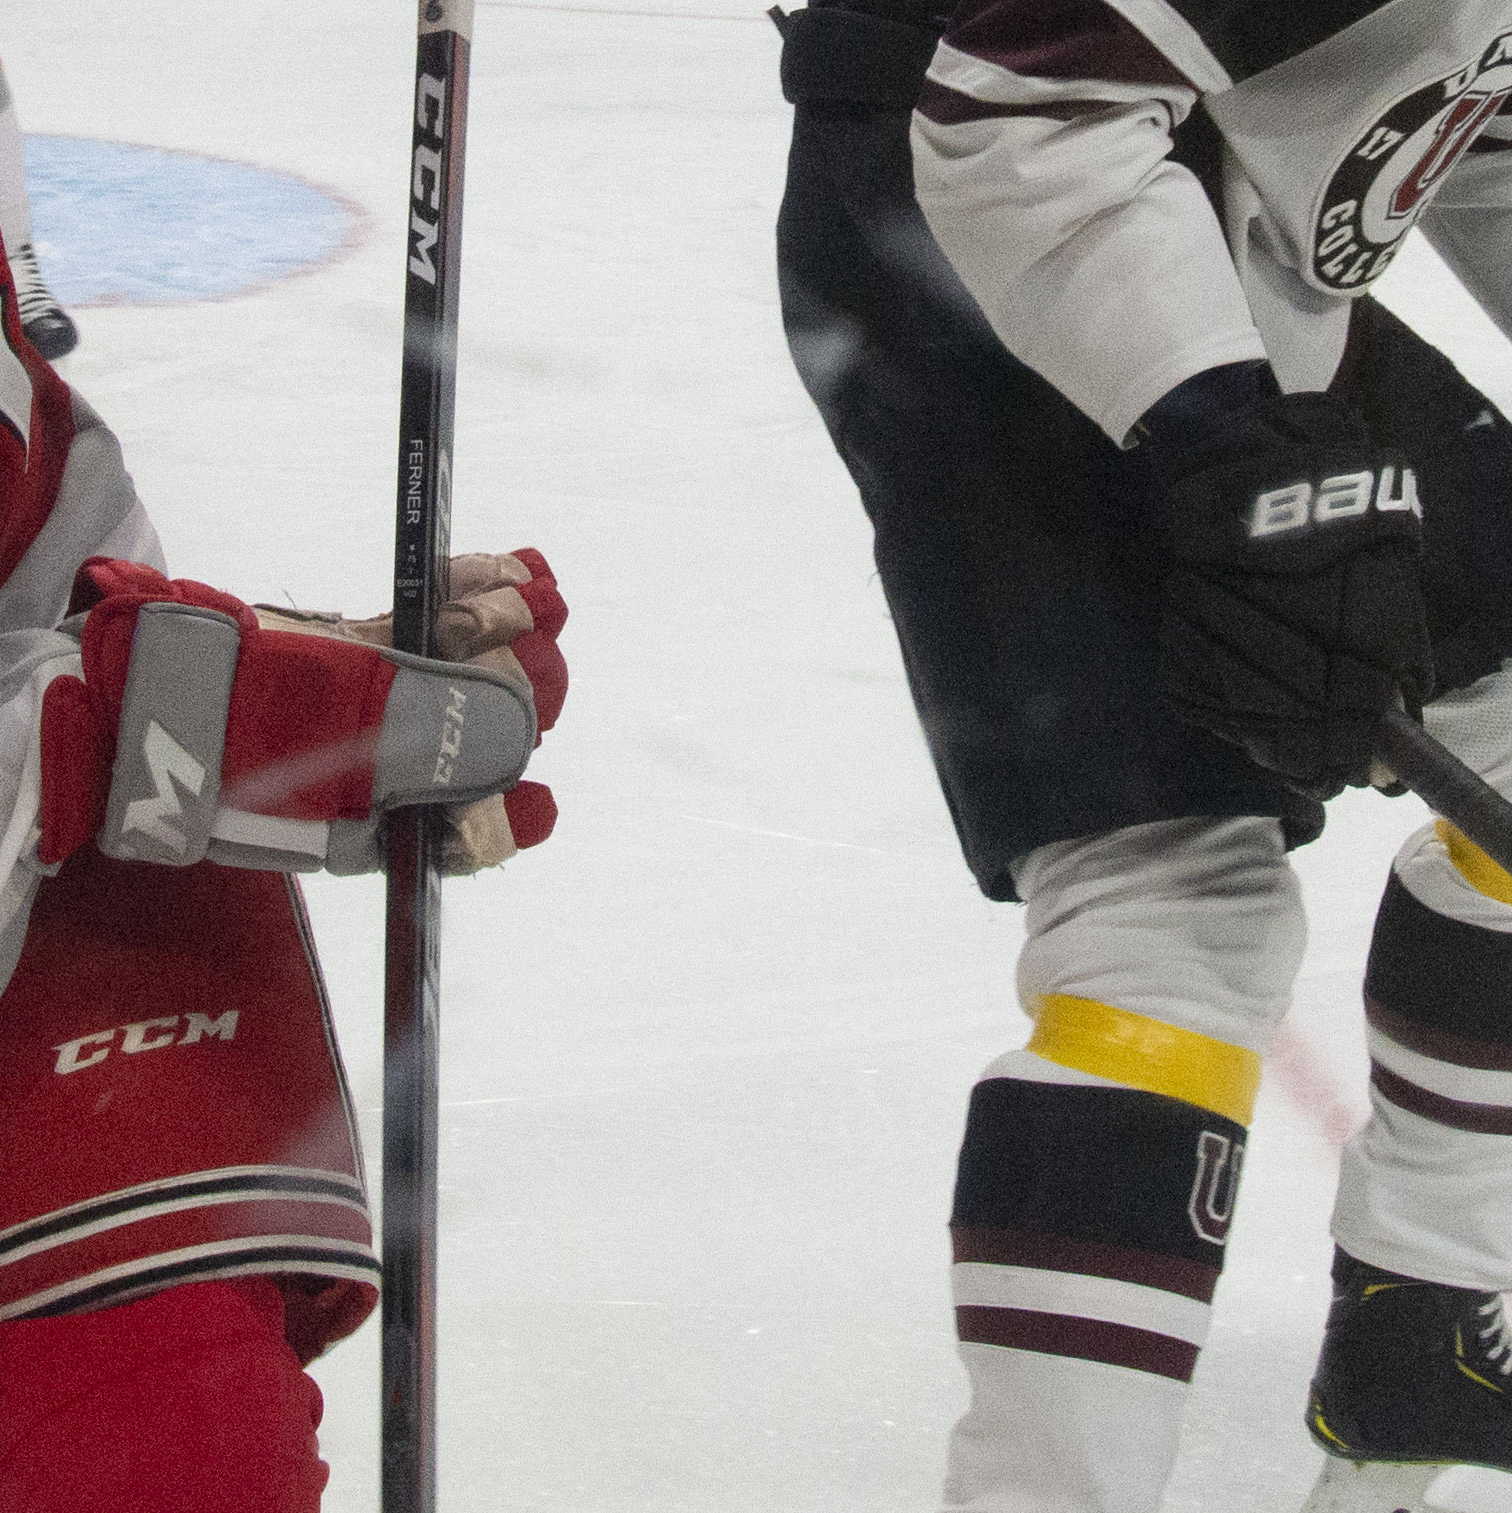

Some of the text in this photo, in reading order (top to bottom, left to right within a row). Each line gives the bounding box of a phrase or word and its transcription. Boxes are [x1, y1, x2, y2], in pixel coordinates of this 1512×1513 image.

[408, 72, 447, 286] CCM
[406, 439, 424, 525] FERNER
[51, 1009, 240, 1075] CCM
